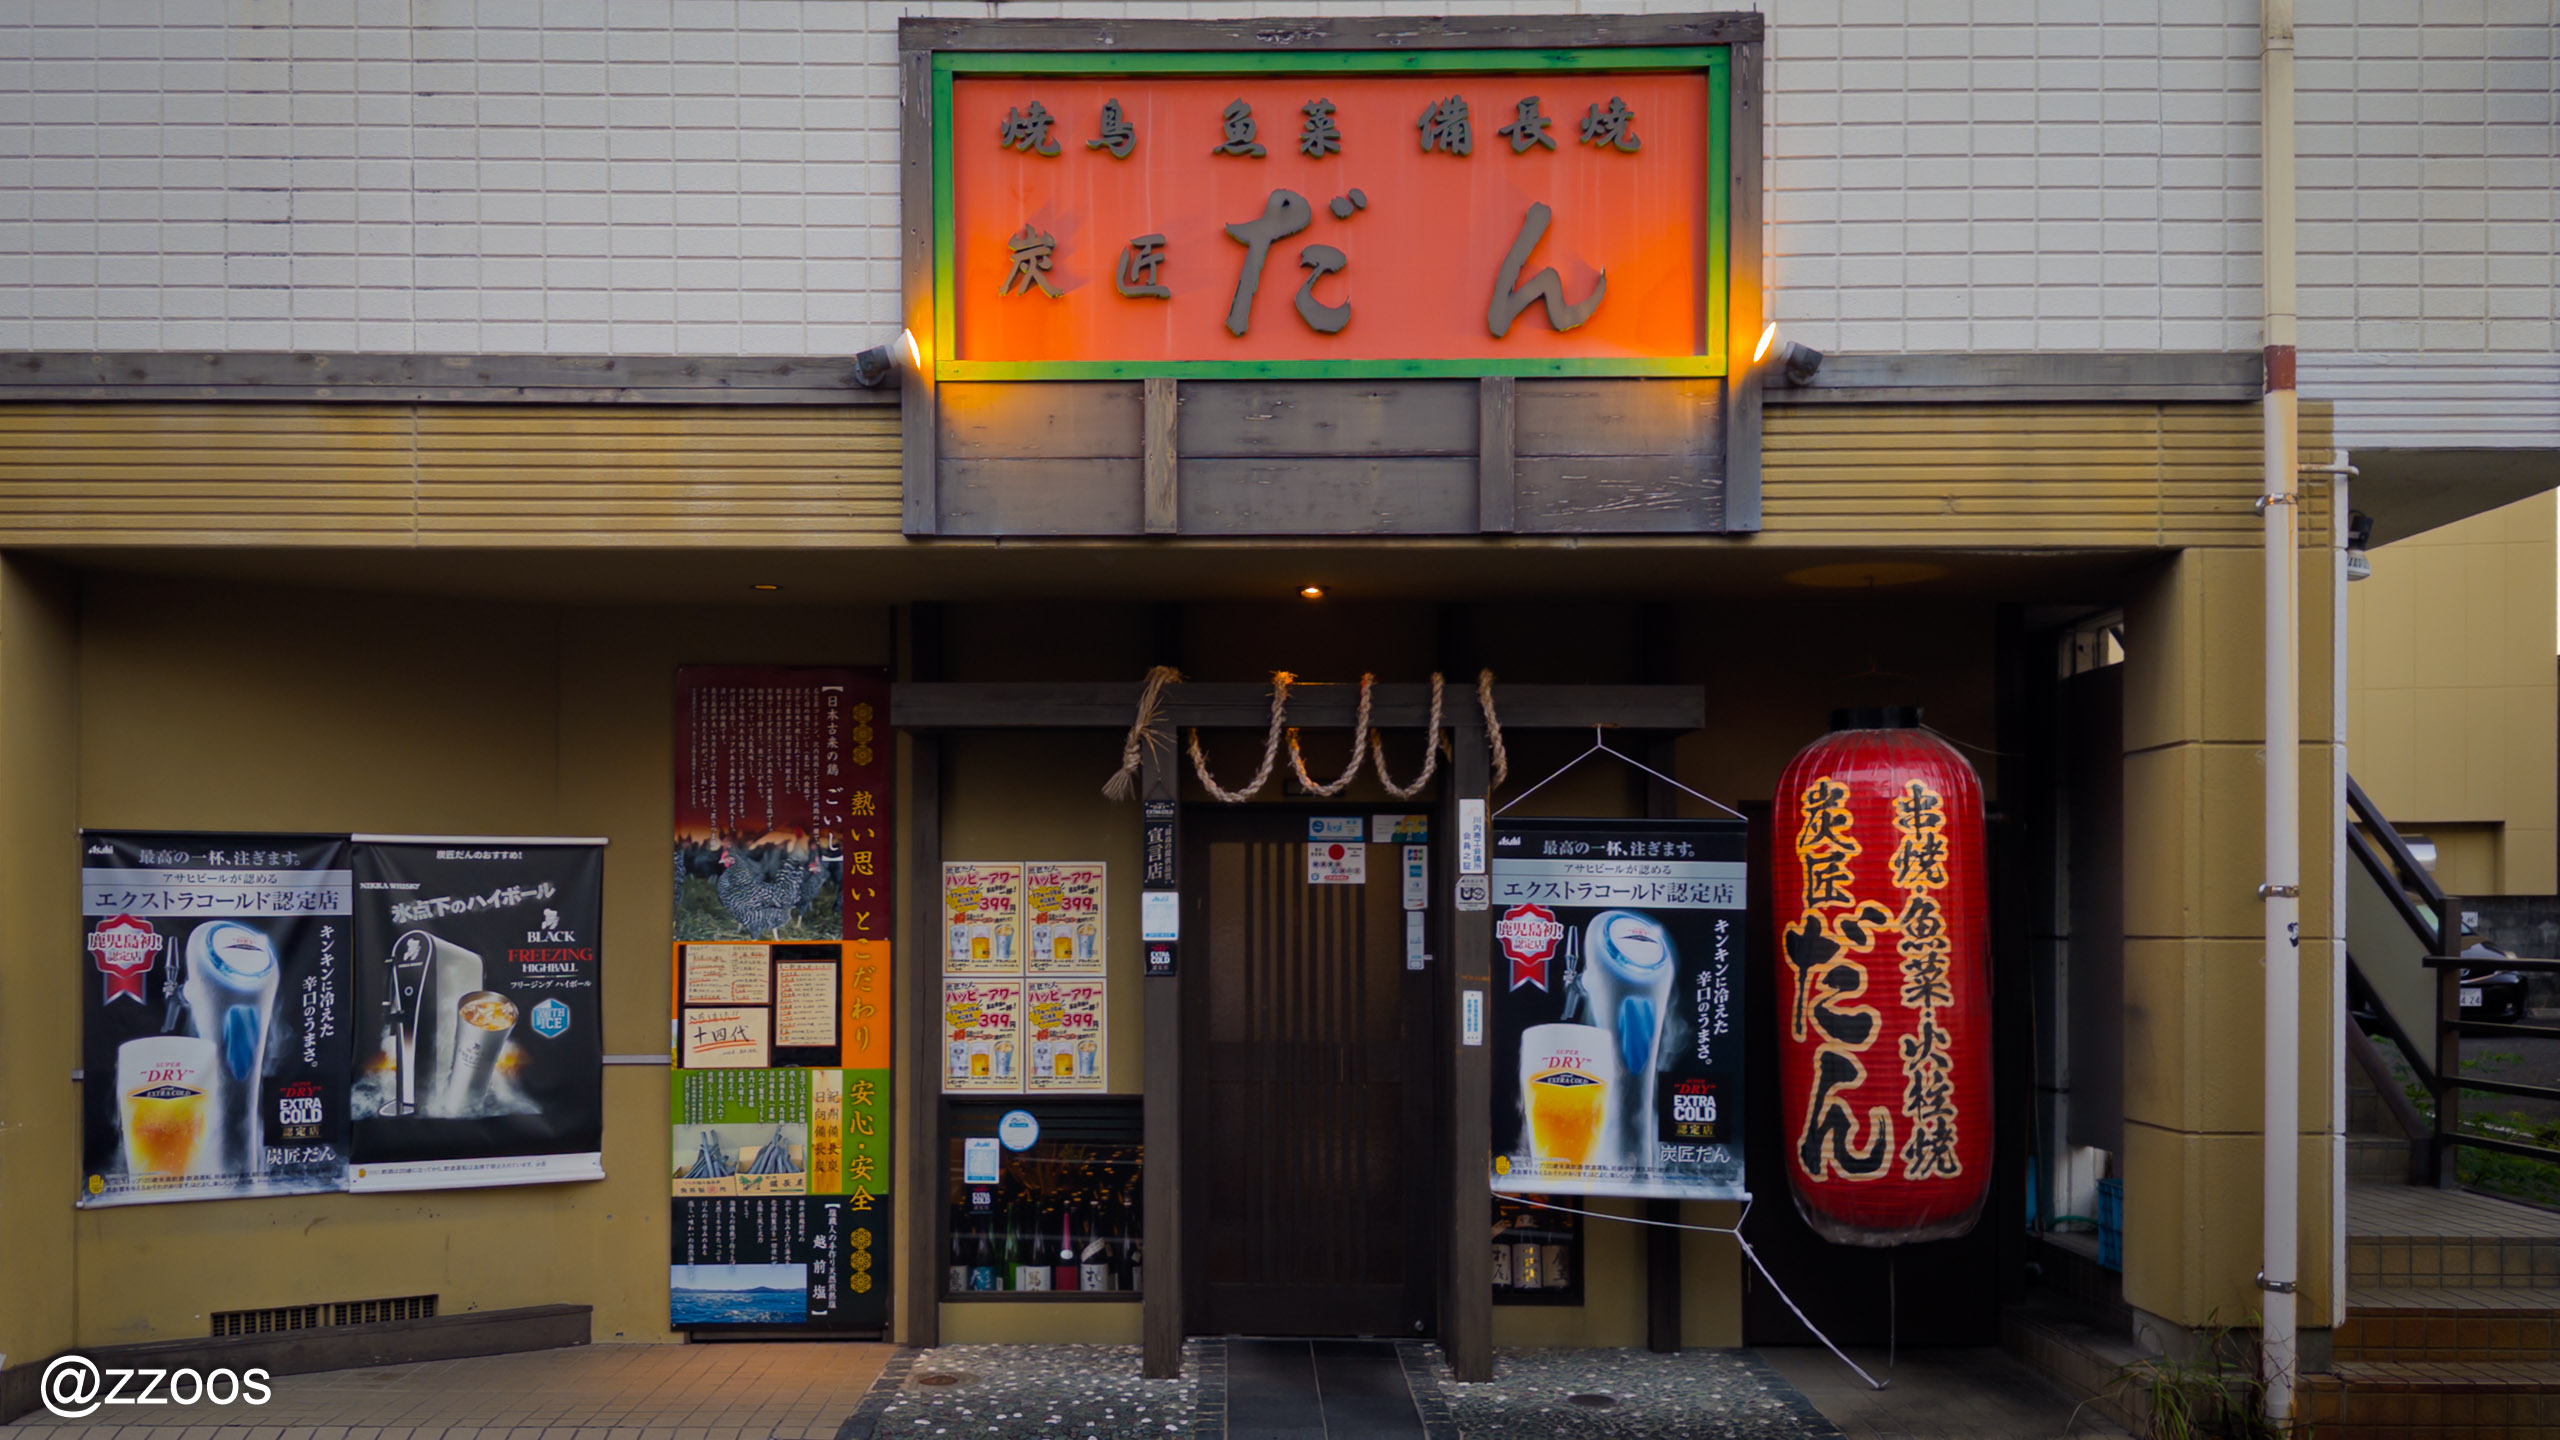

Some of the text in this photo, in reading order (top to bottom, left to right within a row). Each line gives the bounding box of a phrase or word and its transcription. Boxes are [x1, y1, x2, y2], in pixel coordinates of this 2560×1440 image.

[1000, 95, 1642, 158] 焼鳥 魚菜 備長焼
[1498, 836, 1521, 846] Asahi
[1542, 840, 1697, 857] 最高の一杯、注ぎます。
[138, 849, 302, 867] 最高の一杯、注ぎます。
[1147, 826, 1164, 880] 宣言店
[1563, 863, 1672, 876] アサヒビールが認める
[162, 872, 278, 885] アサヒビールが認める
[359, 882, 387, 890] NIKKA
[946, 872, 1020, 886] ハッピーアワー
[1028, 872, 1102, 886] ハッピーアワー
[1503, 881, 1734, 904] エクストラコールド認定店
[95, 890, 339, 912] エクストラコールド認定店
[391, 881, 556, 925] 氷点下のハイボール
[851, 790, 875, 1053] 熱い思いとこだわり
[526, 930, 575, 943] BLACK
[1514, 938, 1546, 950] 認定店
[107, 951, 142, 962] 認定店
[507, 947, 593, 963] FREEZING
[521, 963, 579, 974] HIGHBALL
[1713, 918, 1730, 1035] キンキンに冷えた
[319, 924, 335, 1038] キンキンに冷えた
[510, 979, 592, 990] フリージング ハイボール
[1784, 779, 1888, 1176] 炭匠だん
[946, 989, 1020, 1002] ハッピーアワー
[1028, 989, 1102, 1002] ハッピーアワー
[302, 975, 318, 1068] 辛口のうまさ。
[539, 1017, 563, 1030] ICE
[1696, 970, 1713, 1065] 辛口のうまさ。
[693, 1025, 750, 1045] 十四代
[279, 1098, 322, 1111] EXTRA
[1673, 1094, 1716, 1107] EXTRA
[279, 1108, 323, 1125] COLD
[1673, 1106, 1717, 1122] COLD
[282, 1125, 320, 1137] 認定店
[814, 1090, 826, 1173] 日向備長炭
[827, 1090, 839, 1173] 紀州備長炭
[1676, 1124, 1713, 1135] 認定店
[849, 1080, 877, 1213] 安心・安全
[1659, 1144, 1731, 1164] 炭匠だん
[265, 1146, 336, 1165] 炭匠だん
